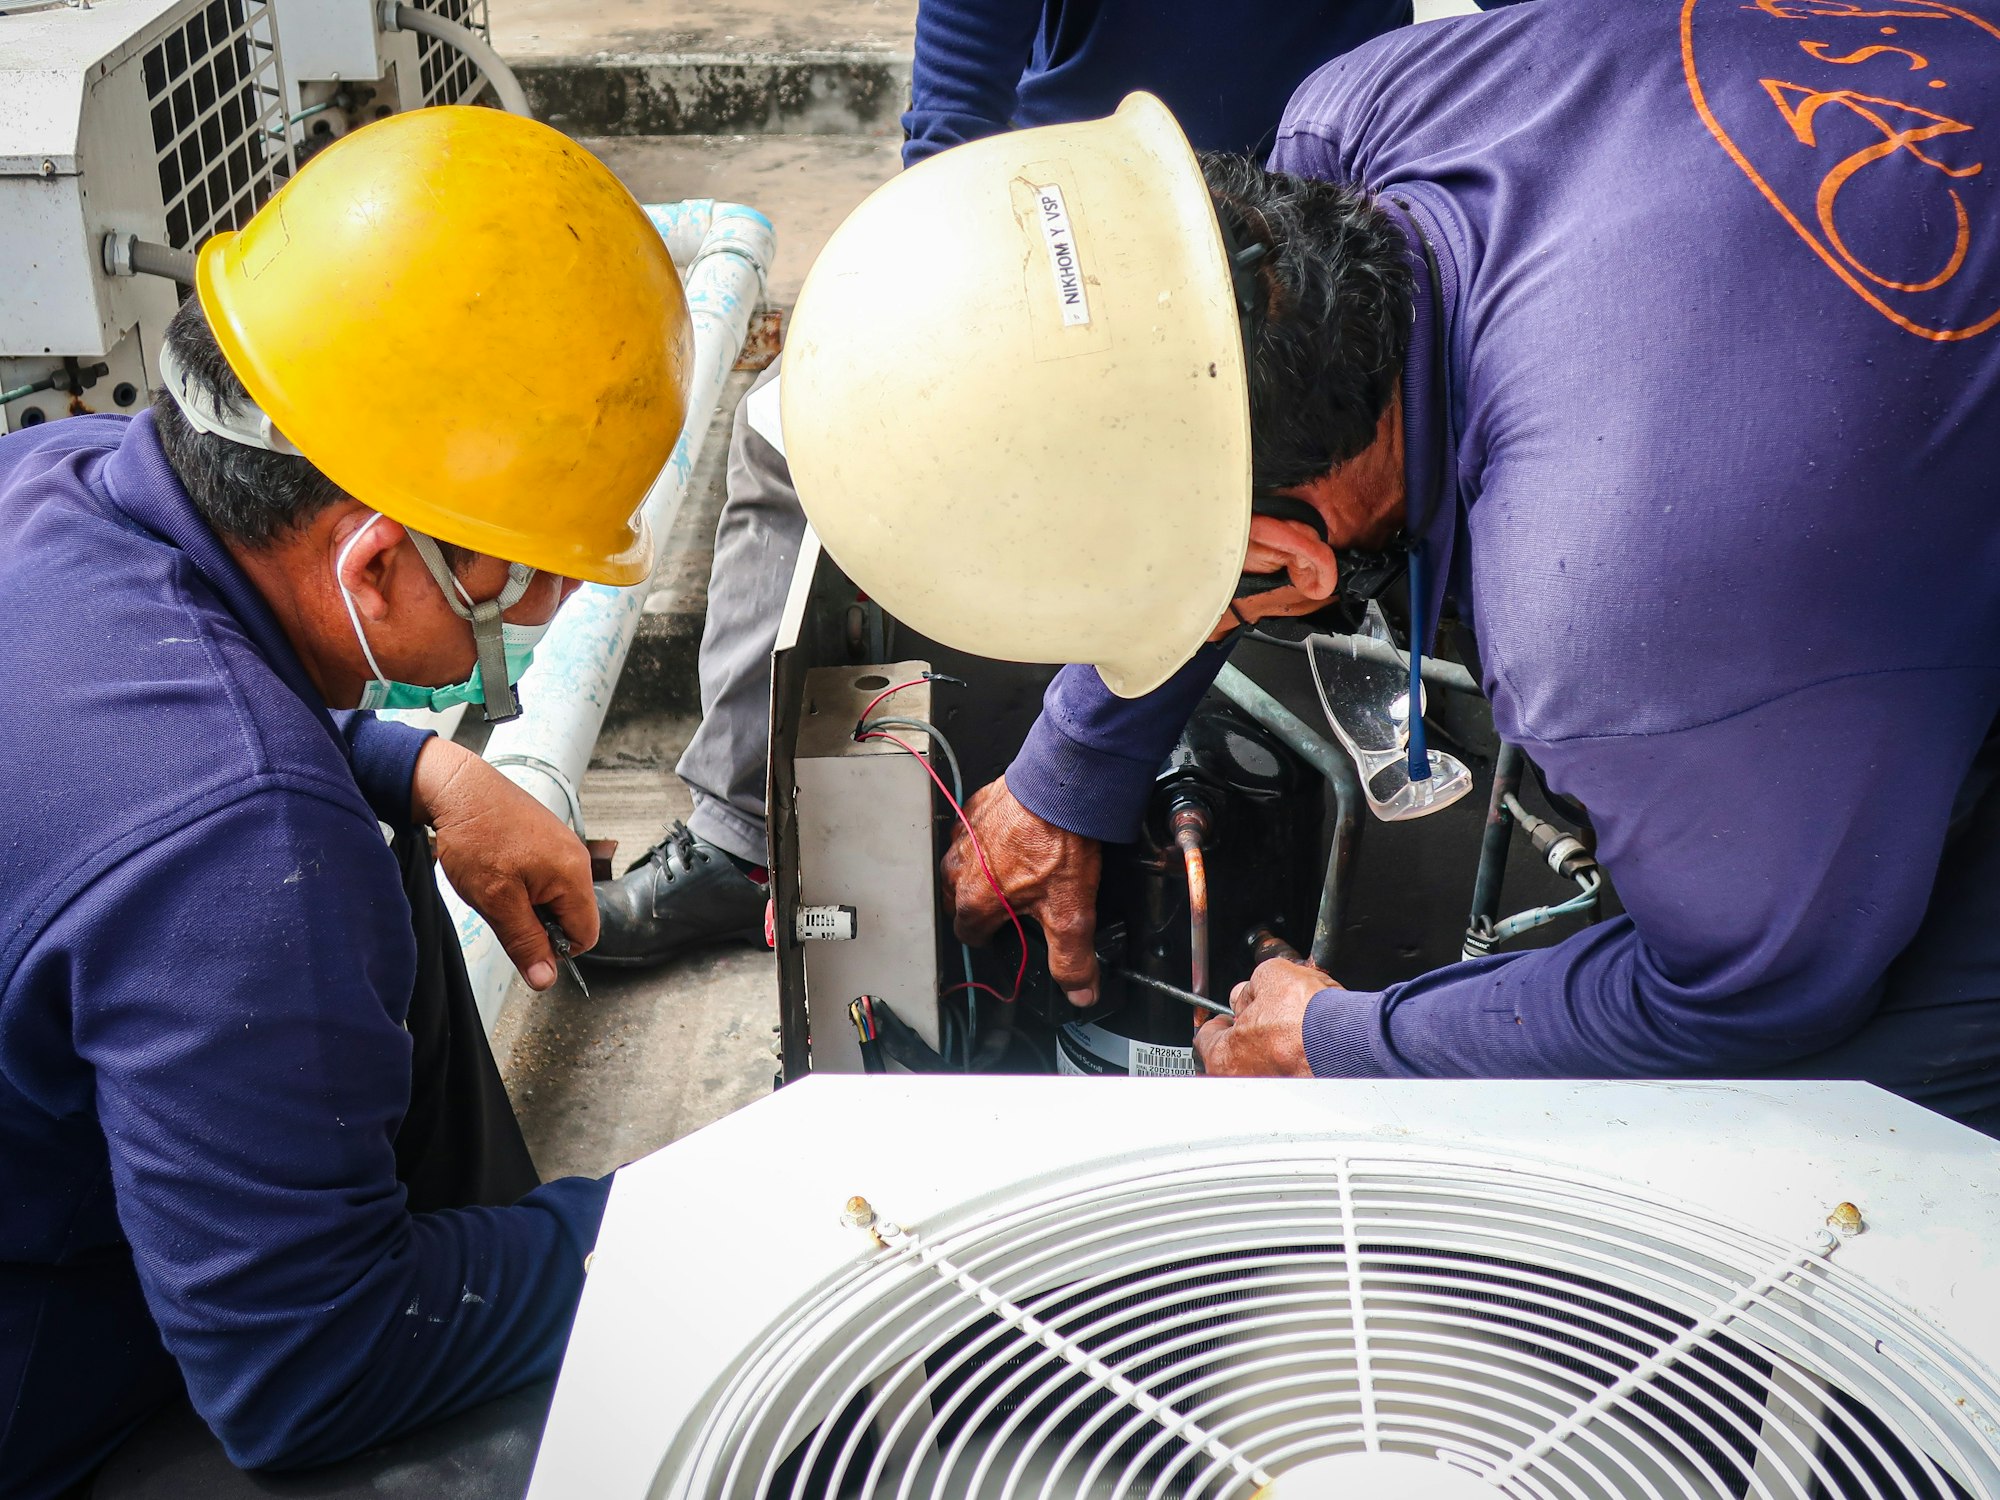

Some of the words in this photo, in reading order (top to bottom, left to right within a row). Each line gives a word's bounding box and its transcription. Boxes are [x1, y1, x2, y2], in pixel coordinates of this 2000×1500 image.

[1041, 196, 1061, 221] VSP
[1050, 228, 1065, 237] Y
[1054, 242, 1080, 305] NIKHOM
[1082, 1057, 1104, 1073] Scroll
